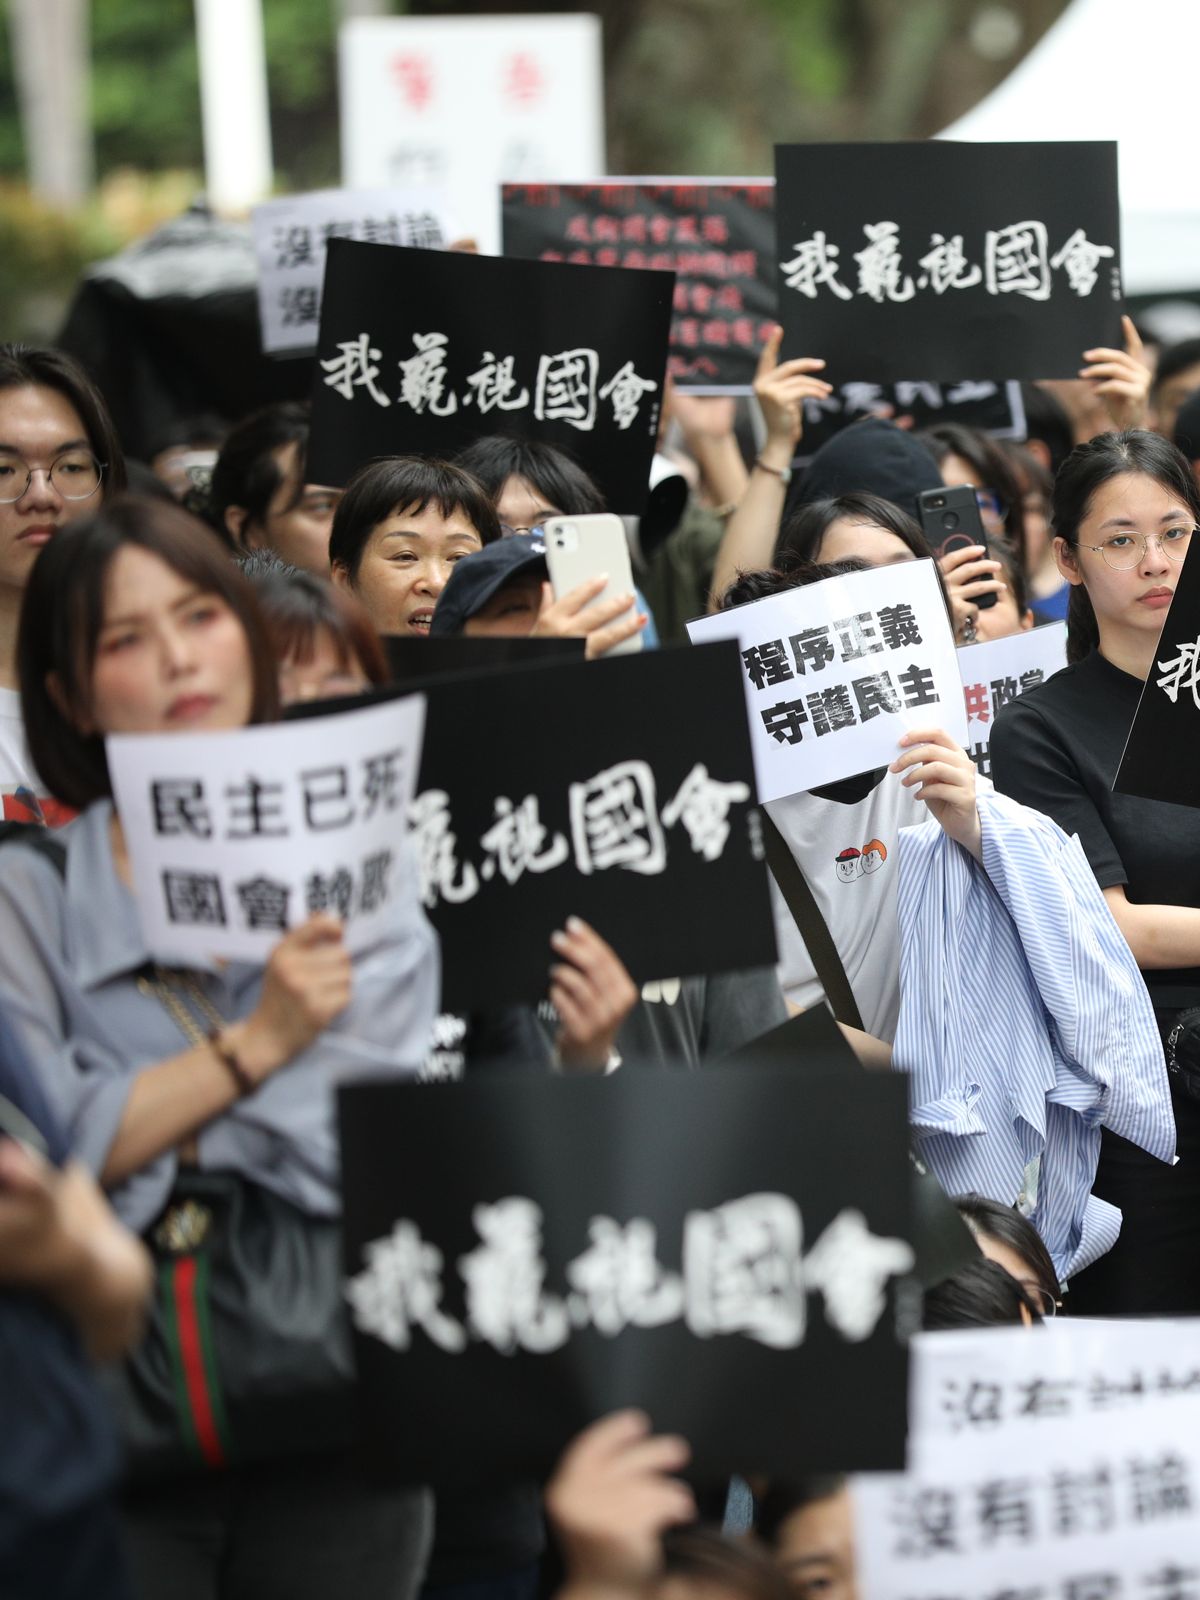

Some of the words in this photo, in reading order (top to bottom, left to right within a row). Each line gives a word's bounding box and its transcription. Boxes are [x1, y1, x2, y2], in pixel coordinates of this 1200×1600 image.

[784, 220, 1116, 302] 我藐視國會
[320, 332, 657, 431] 我藐視國會
[740, 603, 923, 690] 程序正義
[760, 664, 940, 745] 守護民主
[149, 746, 404, 838] 民主已死
